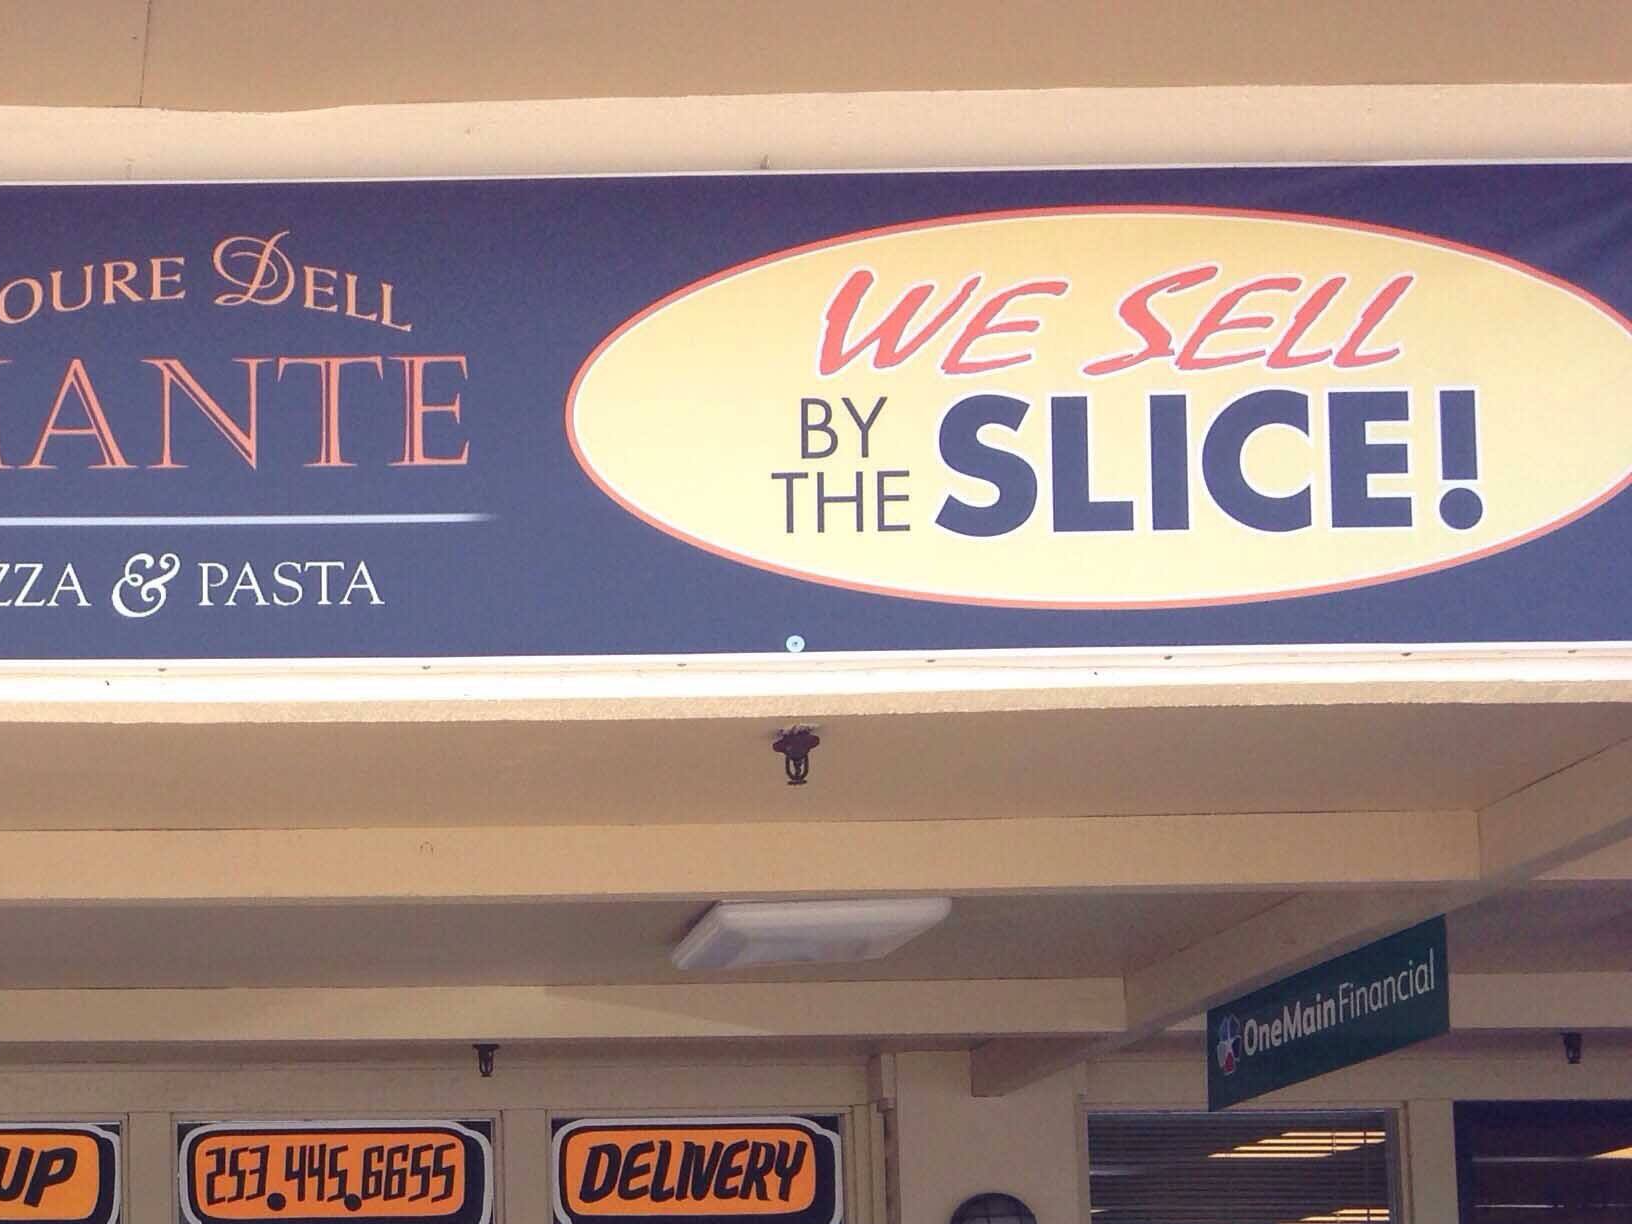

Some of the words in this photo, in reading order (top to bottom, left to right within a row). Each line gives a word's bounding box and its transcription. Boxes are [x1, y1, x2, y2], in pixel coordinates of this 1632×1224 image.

[212, 230, 413, 333] DELL
[817, 268, 1068, 376] WE
[1083, 264, 1414, 376] SELL
[801, 396, 888, 458] BY
[935, 389, 1485, 537] SLICE!
[770, 470, 911, 534] THE
[111, 552, 180, 618] &
[197, 561, 385, 606] PASTA
[205, 1143, 457, 1211] 253.445.6655
[579, 1139, 808, 1203] DELIVERY
